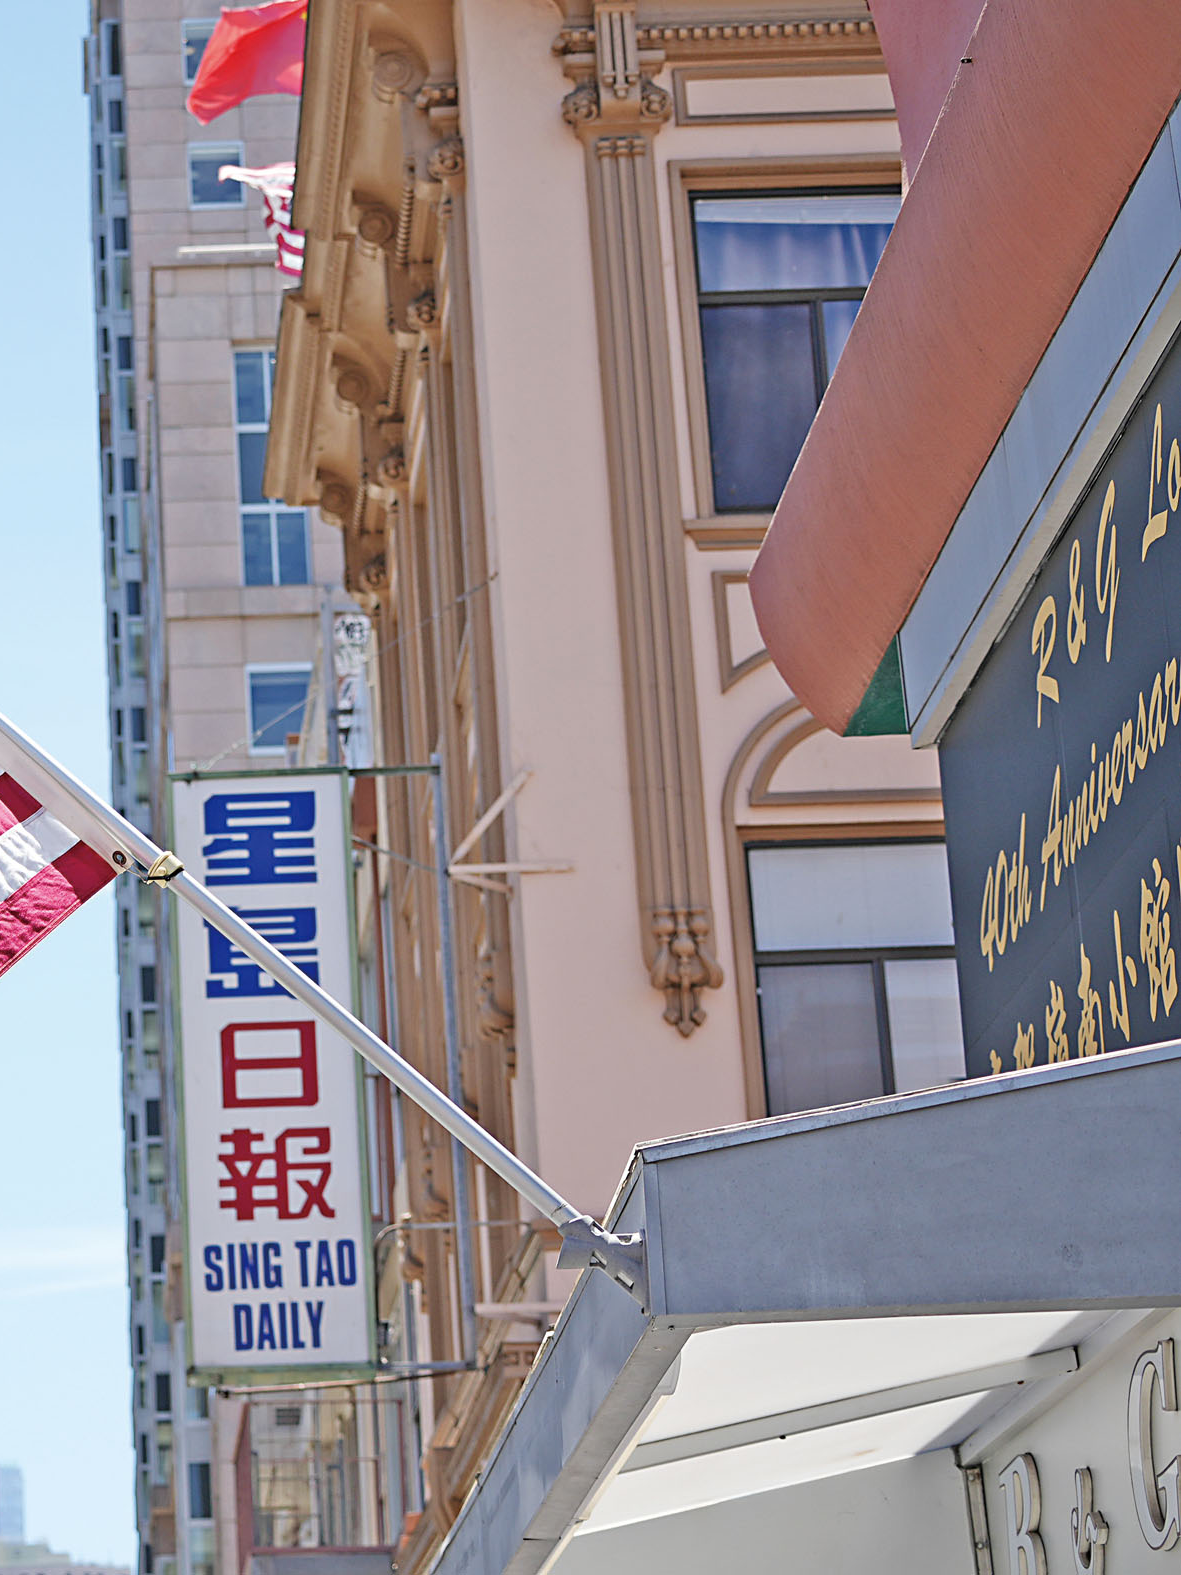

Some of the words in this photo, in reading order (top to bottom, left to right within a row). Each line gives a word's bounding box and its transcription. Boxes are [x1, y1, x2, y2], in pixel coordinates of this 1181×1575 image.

[980, 812, 1032, 970] 40th
[1040, 657, 1181, 912] Anniversar
[203, 791, 335, 1221] 星島日報
[203, 1242, 283, 1292] SING
[294, 1238, 357, 1288] TAO
[233, 1301, 324, 1352] DAILY
